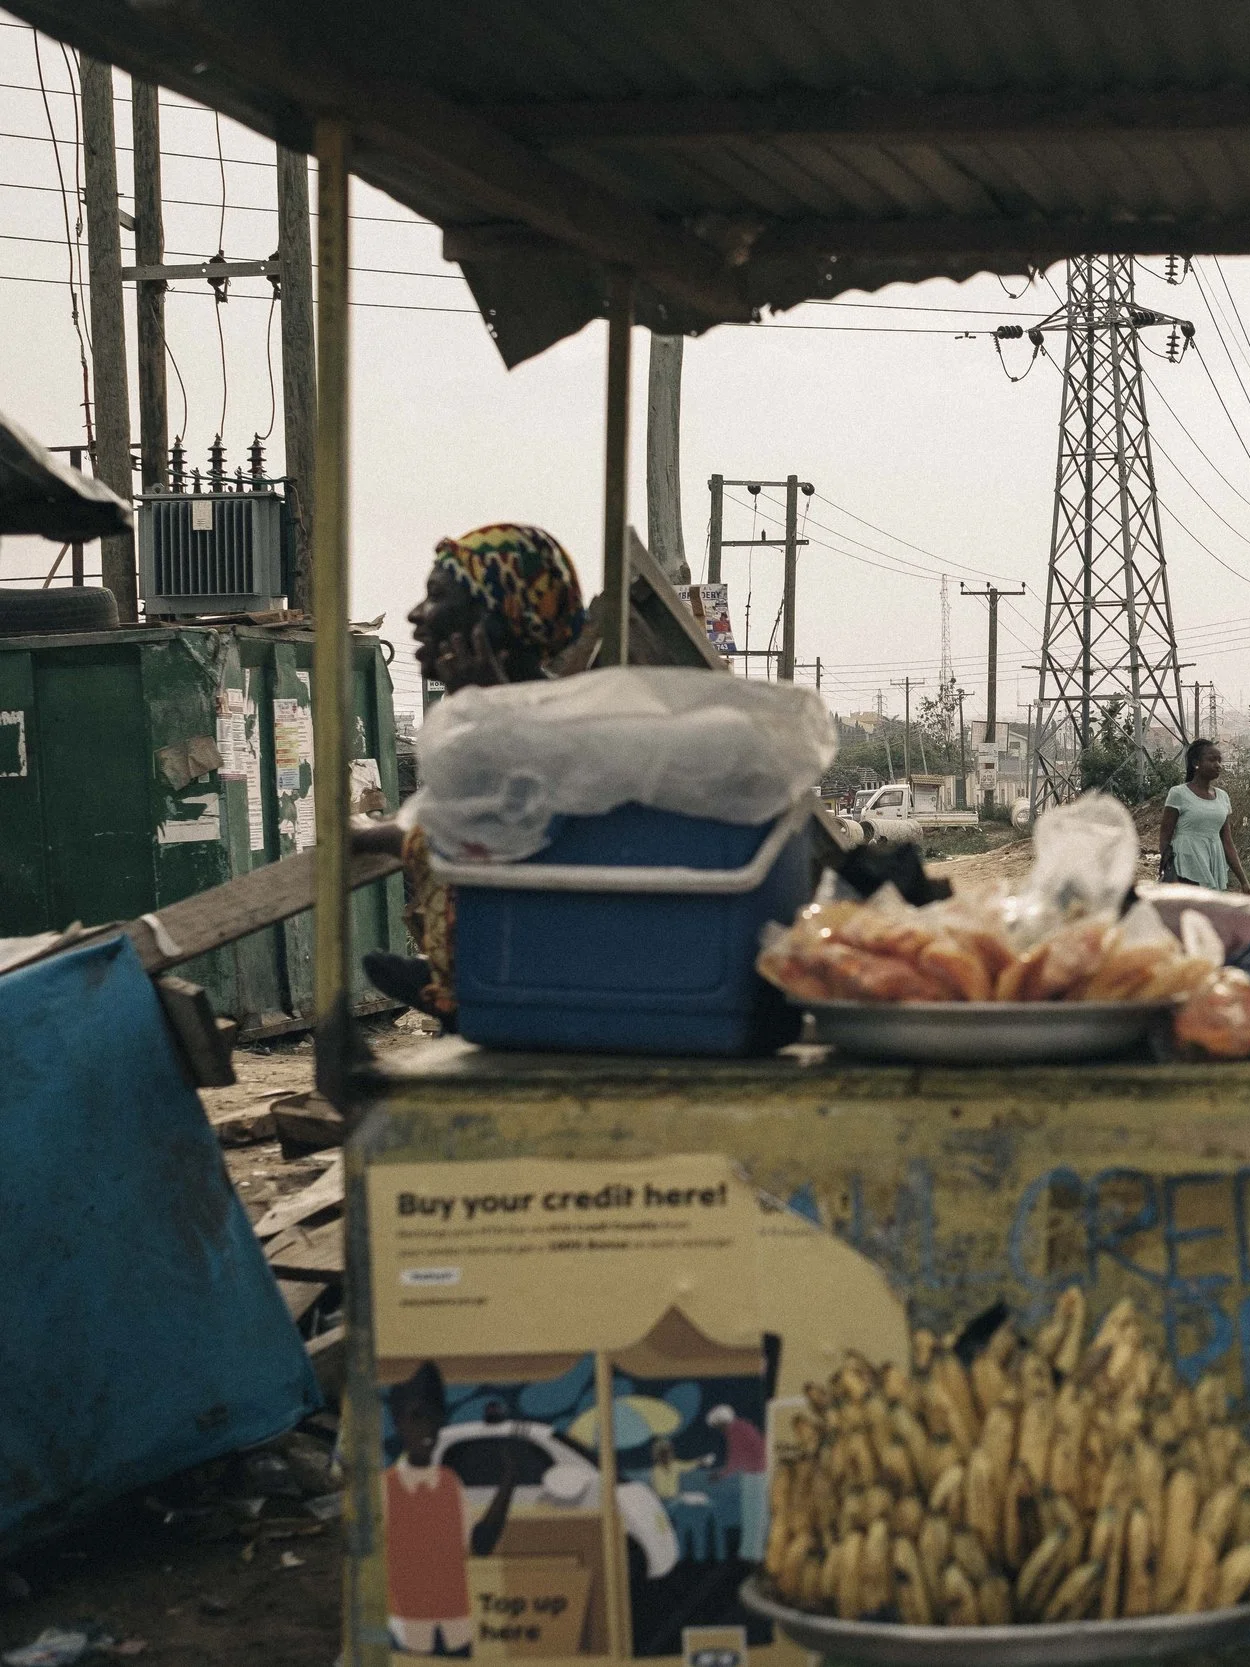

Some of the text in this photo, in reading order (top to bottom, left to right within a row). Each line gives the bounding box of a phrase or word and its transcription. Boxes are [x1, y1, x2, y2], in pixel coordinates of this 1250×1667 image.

[398, 1192, 454, 1220] Buy
[463, 1190, 534, 1219] your
[542, 1183, 634, 1211] credit
[643, 1181, 728, 1208] here!
[479, 1592, 567, 1619] Top up
[480, 1623, 541, 1641] here
